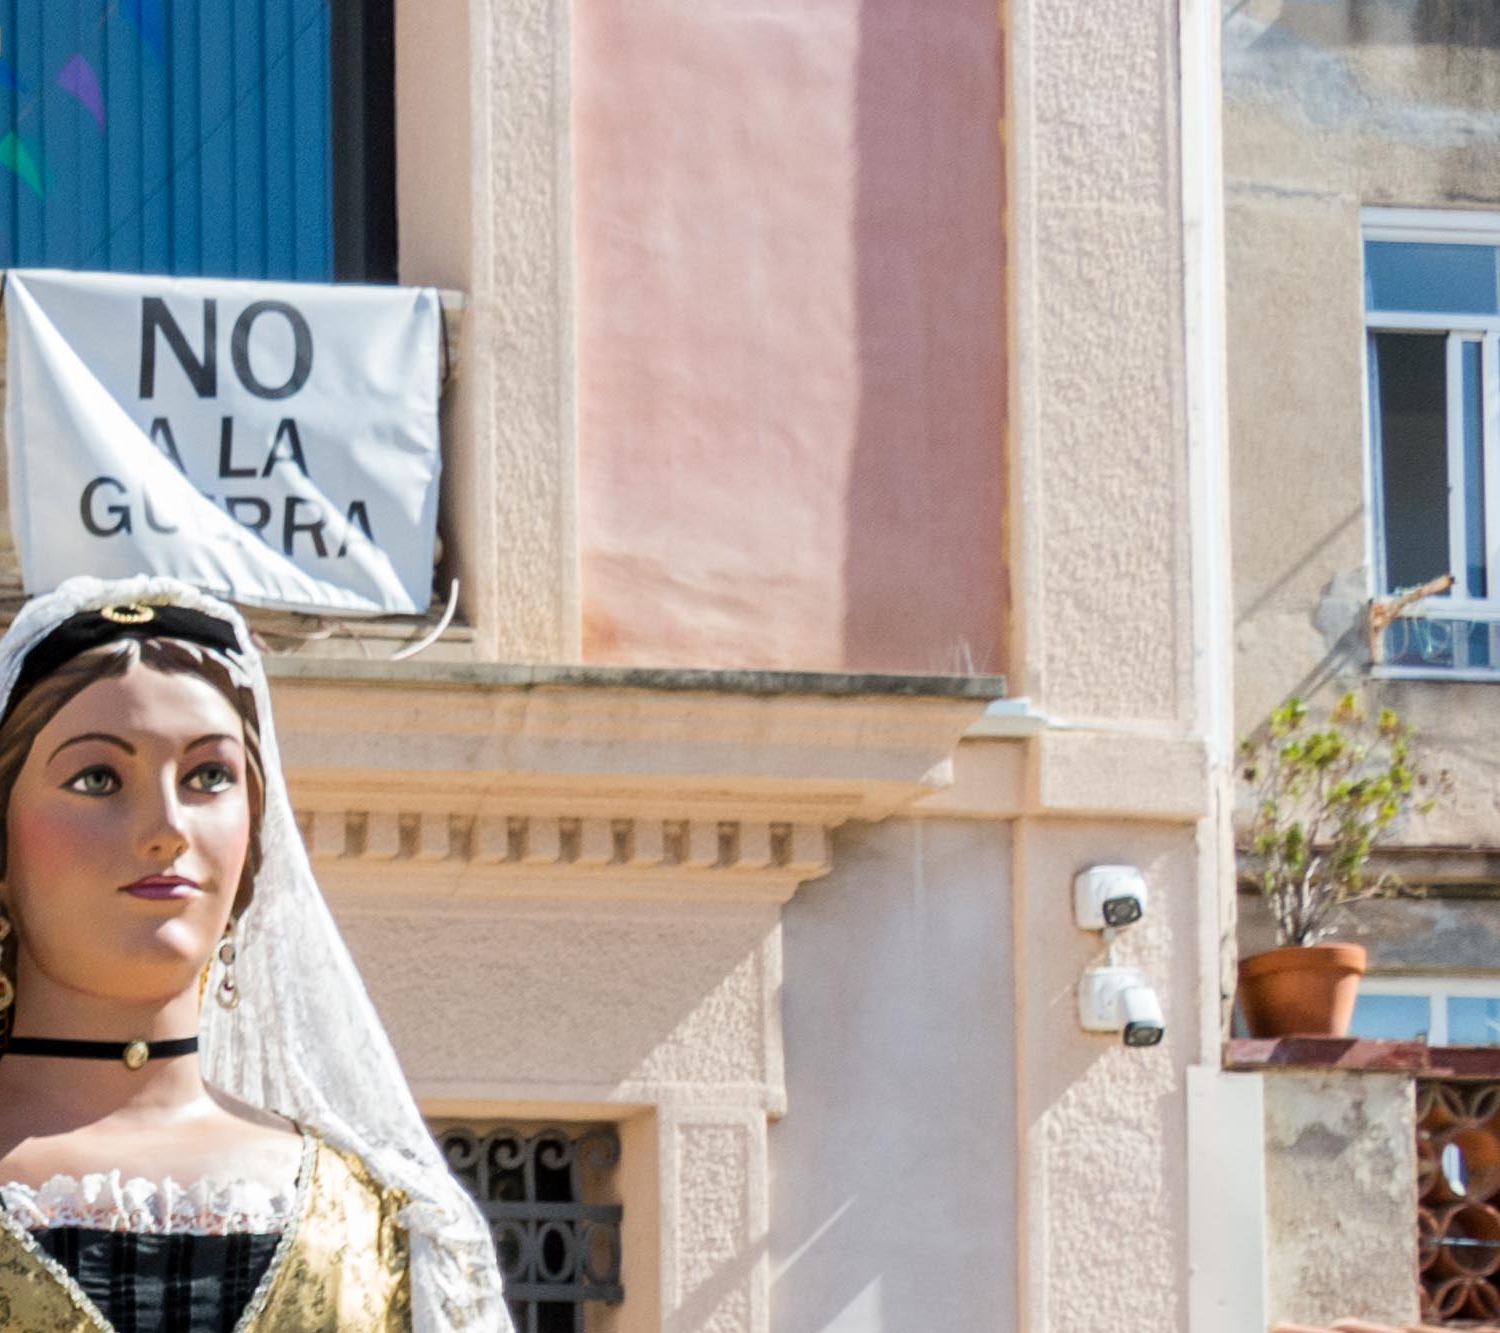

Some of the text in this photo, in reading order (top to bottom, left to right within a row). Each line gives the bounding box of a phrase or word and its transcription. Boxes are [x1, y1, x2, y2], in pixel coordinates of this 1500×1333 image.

[139, 296, 313, 400] NO
[148, 416, 310, 478] A LA
[80, 476, 376, 558] GURRA
